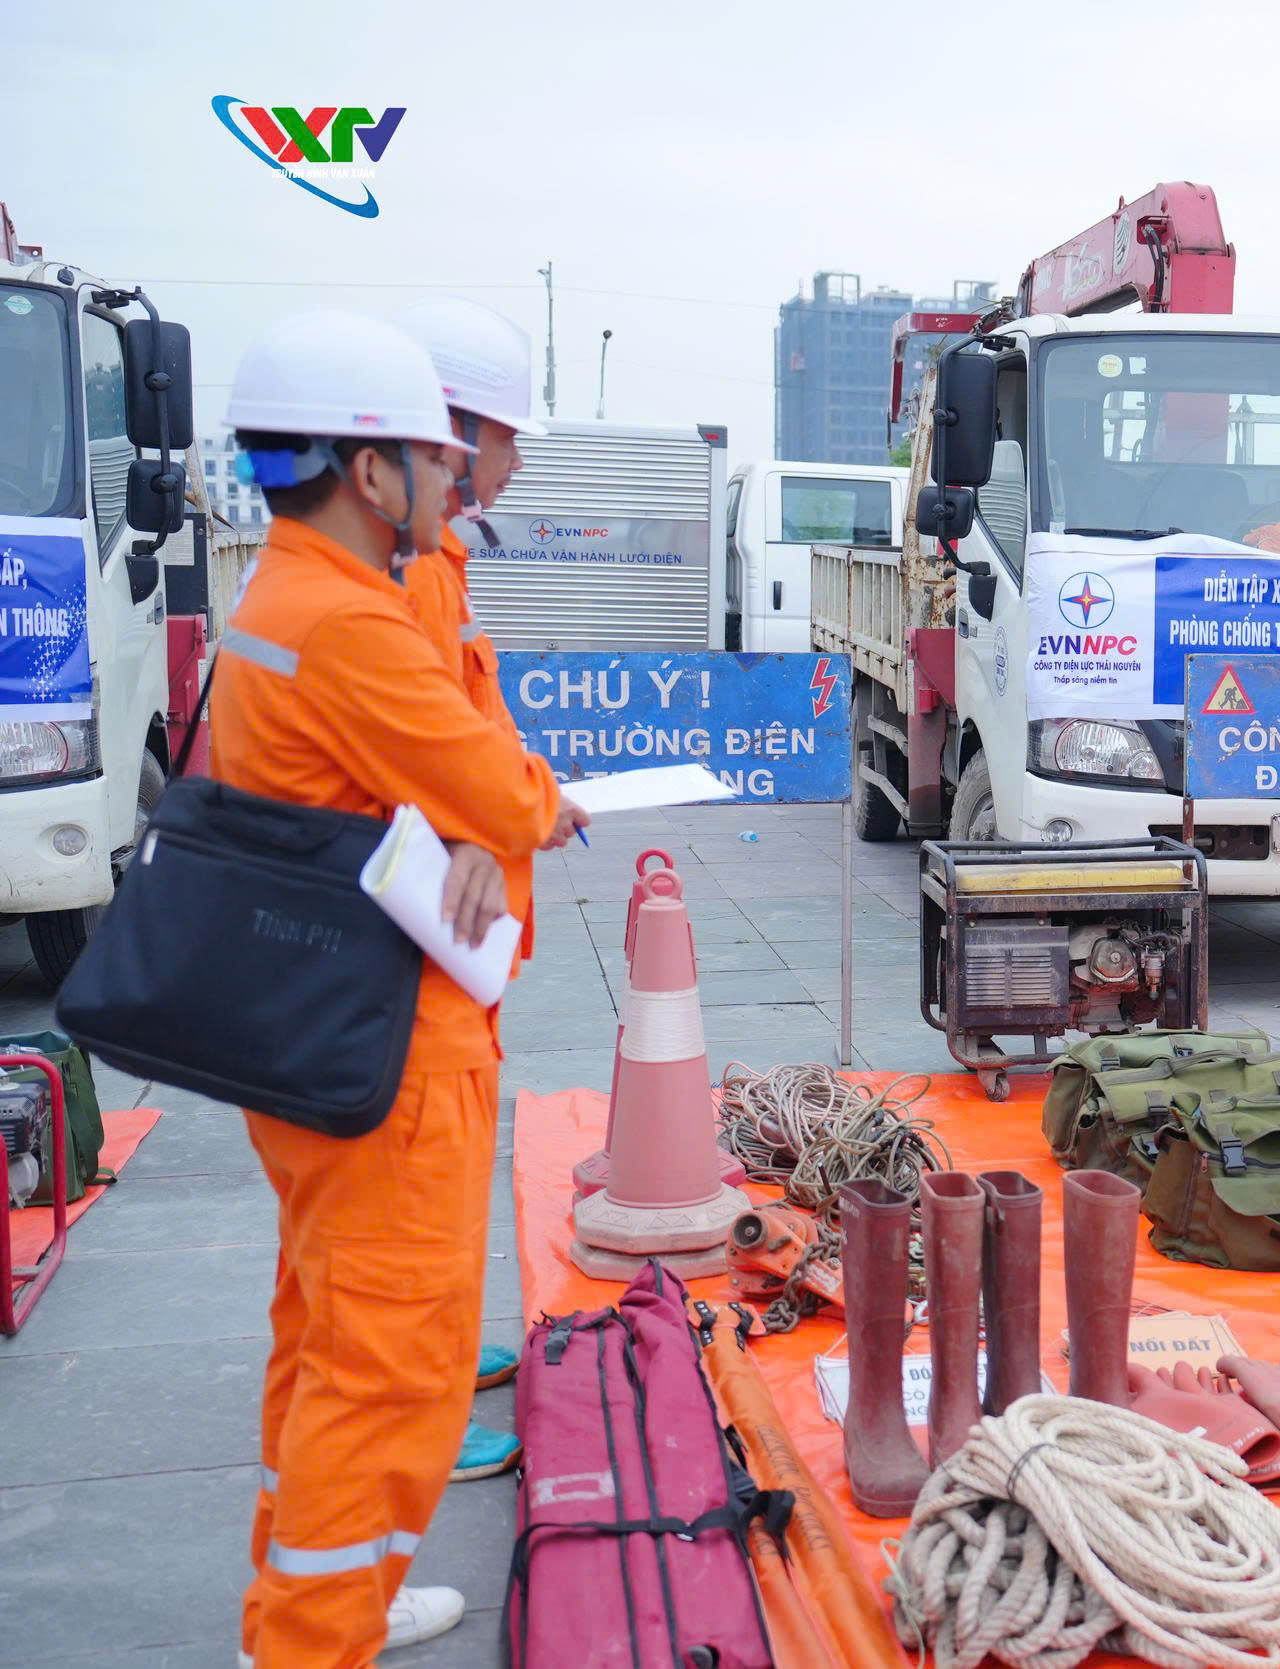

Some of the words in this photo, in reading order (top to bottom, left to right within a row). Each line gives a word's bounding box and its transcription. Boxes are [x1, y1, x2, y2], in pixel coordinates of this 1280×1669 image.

[556, 528, 609, 538] EVNNPC
[0, 547, 28, 590] ẤP,
[551, 549, 577, 563] VẬN
[581, 550, 615, 562] HÀNH
[620, 551, 650, 563] LƯỚI
[654, 552, 682, 566] ĐIỆN
[1204, 569, 1238, 602] DIỄN
[1242, 573, 1269, 609] TẬP
[12, 602, 69, 637] THÔNG
[1169, 614, 1218, 646] PHÒNG
[1223, 612, 1271, 647] CHỐNG
[1038, 635, 1137, 655] EVNNPC
[1034, 659, 1053, 671] CÔNG
[1054, 662, 1062, 671] TY
[1063, 659, 1079, 673] ĐIỆN
[1081, 660, 1094, 673] LỰC
[1096, 659, 1111, 671] THÁI
[1113, 660, 1141, 672] NGUYÊN
[519, 660, 630, 709] CHÚ
[648, 660, 683, 709] Ý
[701, 670, 710, 709] !
[542, 721, 711, 757] TRƯỜNG
[725, 720, 816, 761] ĐIỆN
